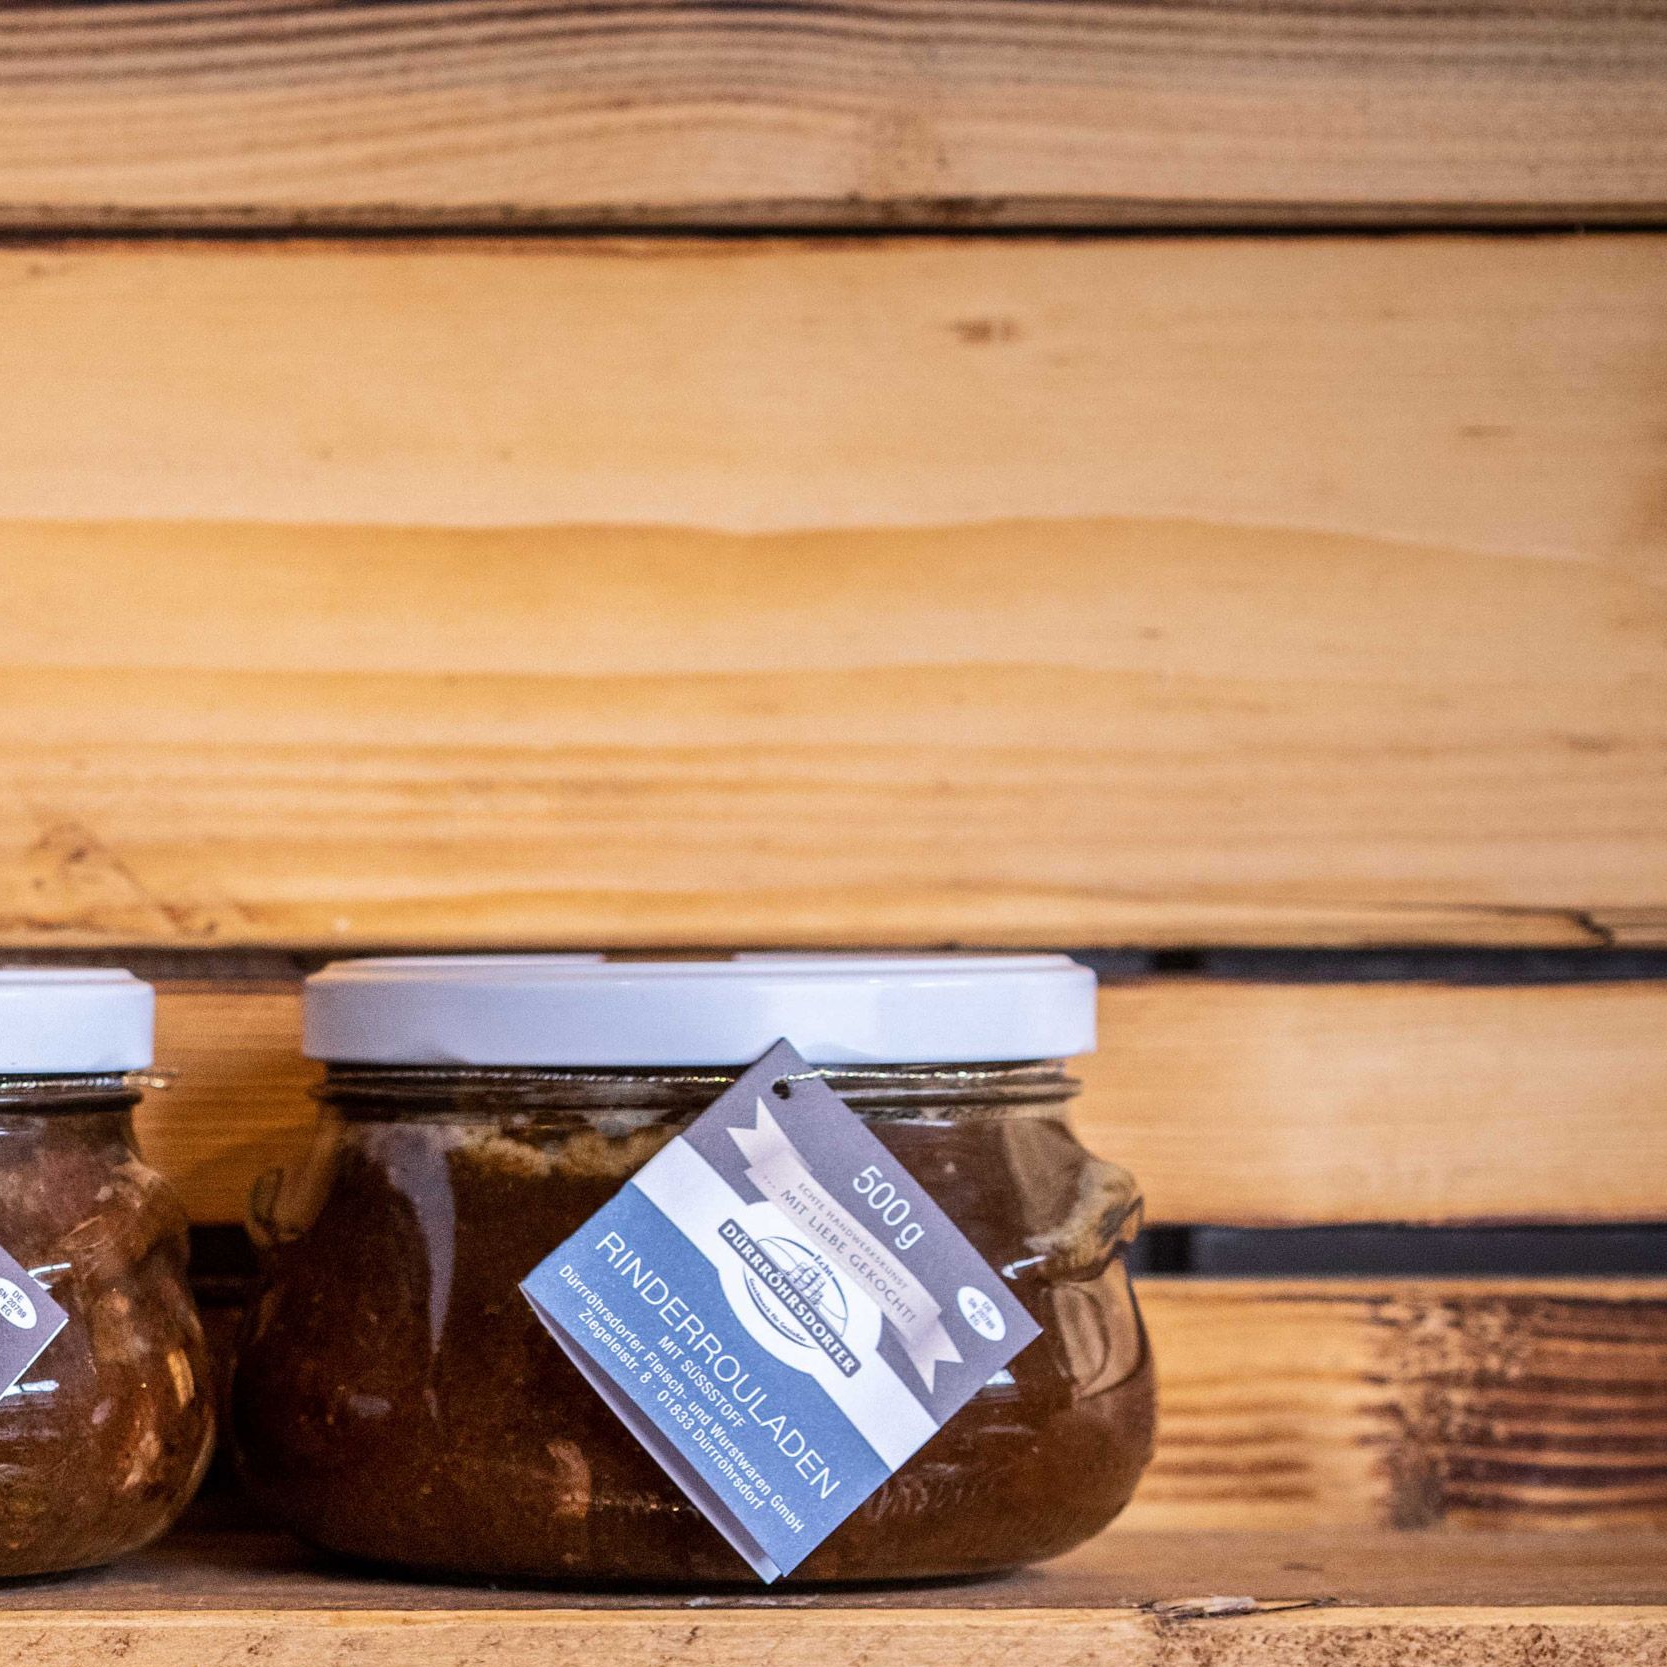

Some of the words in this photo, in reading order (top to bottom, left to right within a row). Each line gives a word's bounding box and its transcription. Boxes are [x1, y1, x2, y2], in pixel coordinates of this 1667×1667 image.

[0, 1303, 13, 1317] EG
[6, 1297, 27, 1319] 20789
[11, 1290, 24, 1303] DE
[722, 1218, 861, 1373] DÜRRRÖHRSDORFER
[780, 1189, 809, 1216] MIT
[808, 1215, 848, 1254] LIEBE
[849, 1253, 918, 1324] GEKOCHT!
[813, 1254, 834, 1277] Echt
[558, 1264, 646, 1353] Dürrröhrsdorfer
[643, 1351, 688, 1400] Fleisch-
[687, 1401, 713, 1426] und
[710, 1422, 772, 1496] Wurstwaren
[770, 1494, 805, 1534] GmbH
[577, 1307, 640, 1374] Ziegeleistr.
[639, 1371, 653, 1384] 8
[656, 1389, 695, 1430] 01833
[691, 1428, 766, 1510] Dürrröhrsdorf
[594, 1231, 841, 1500] RINDERROULADEN
[657, 1335, 684, 1360] MIT
[680, 1359, 747, 1428] SÜSSSTOFF
